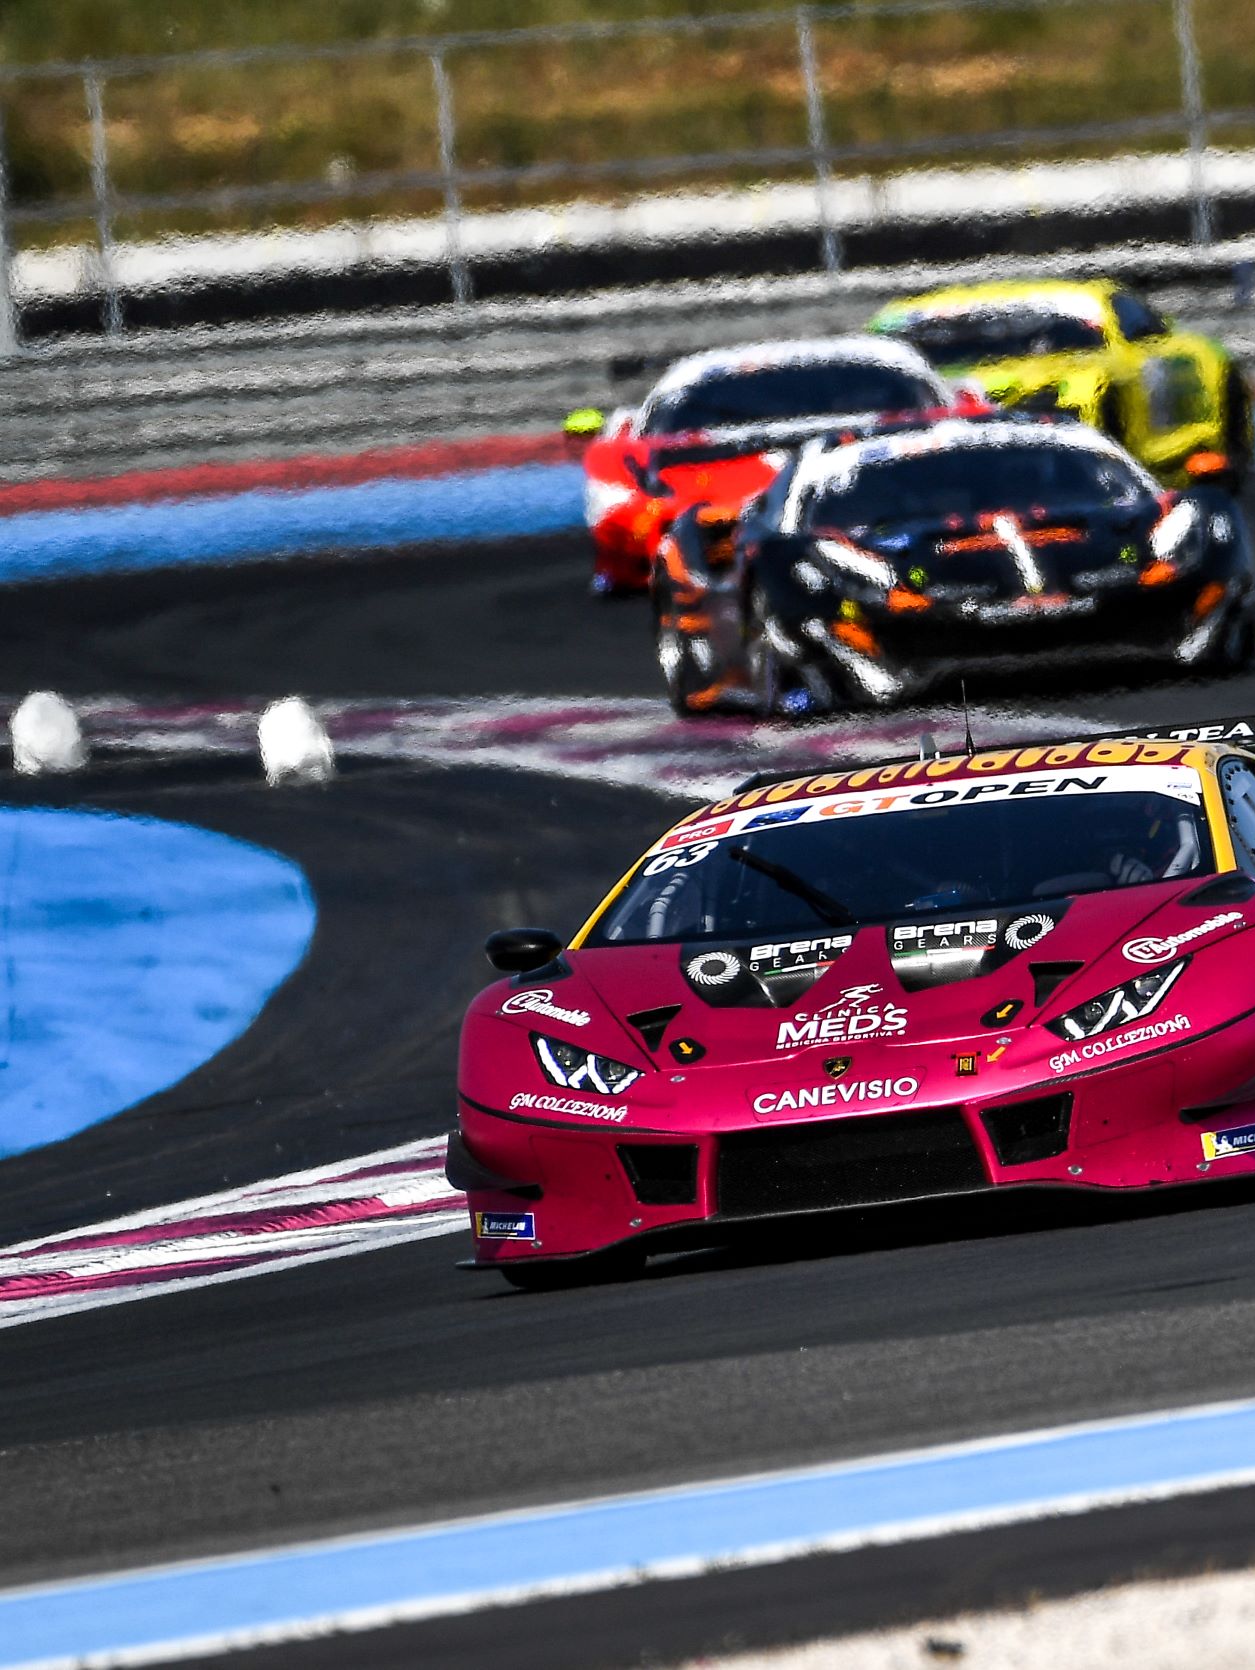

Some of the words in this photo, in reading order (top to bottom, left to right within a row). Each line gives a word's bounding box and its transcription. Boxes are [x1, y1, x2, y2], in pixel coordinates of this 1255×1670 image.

[678, 826, 717, 842] PRO
[643, 840, 719, 877] 63
[893, 919, 998, 941] Brena
[750, 935, 852, 961] Brena
[893, 933, 997, 950] GEARS
[794, 1002, 895, 1022] CLINICA
[776, 1008, 908, 1044] MEDS
[775, 1038, 830, 1050] MEDICINA
[832, 1030, 893, 1042] DEPORTIVA
[1049, 1049, 1082, 1073] GM
[509, 1092, 534, 1110] GM
[753, 1075, 918, 1115] CANEVISIO
